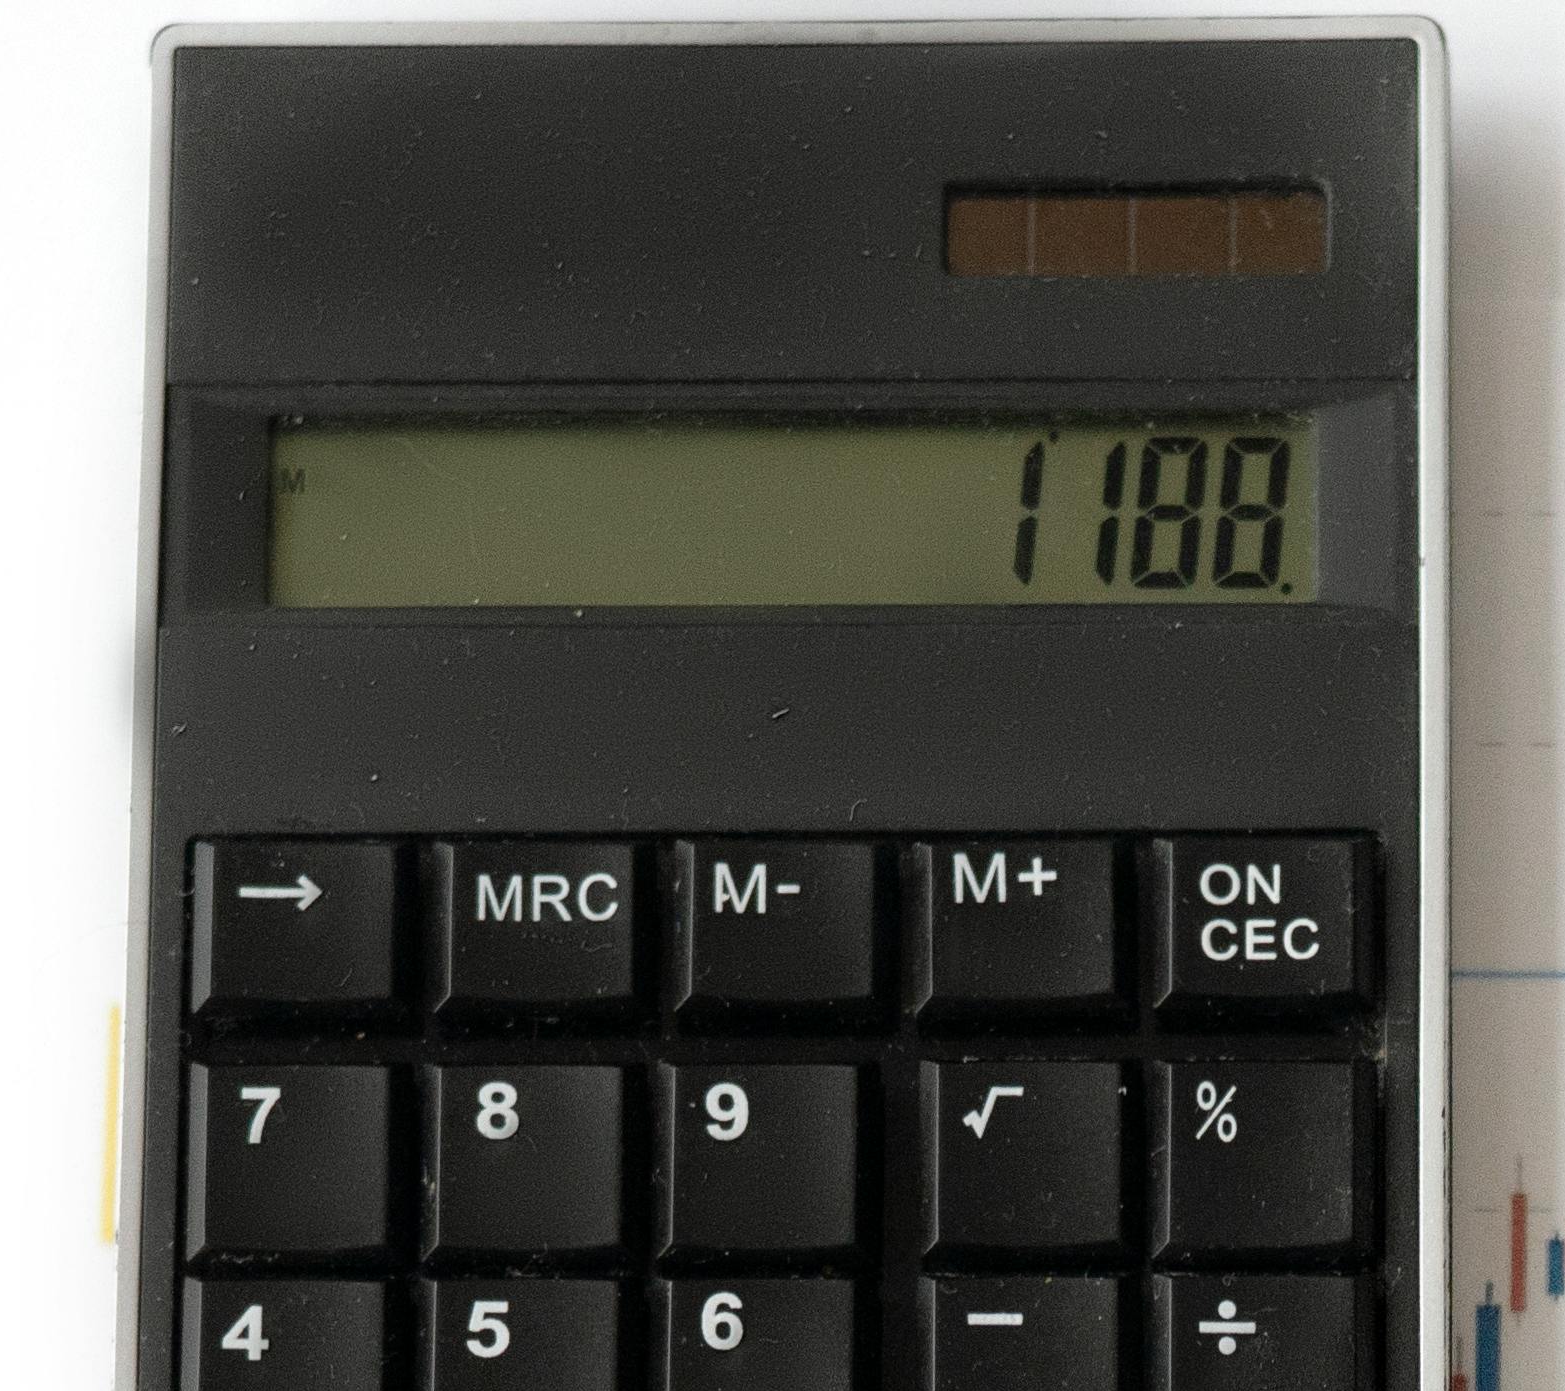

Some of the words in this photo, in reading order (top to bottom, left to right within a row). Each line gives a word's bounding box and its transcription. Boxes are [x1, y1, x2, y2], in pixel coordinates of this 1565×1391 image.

[478, 872, 618, 921] MRC
[714, 862, 800, 914] M-
[953, 852, 1057, 903] M+
[1199, 863, 1281, 905] ON
[1201, 918, 1319, 961] CEC
[241, 1086, 281, 1144] 7
[476, 1081, 519, 1139] 8
[705, 1082, 749, 1141] 9
[1196, 1081, 1237, 1143] %
[221, 1305, 269, 1361] 4
[466, 1300, 510, 1358] 5
[701, 1292, 743, 1350] 6
